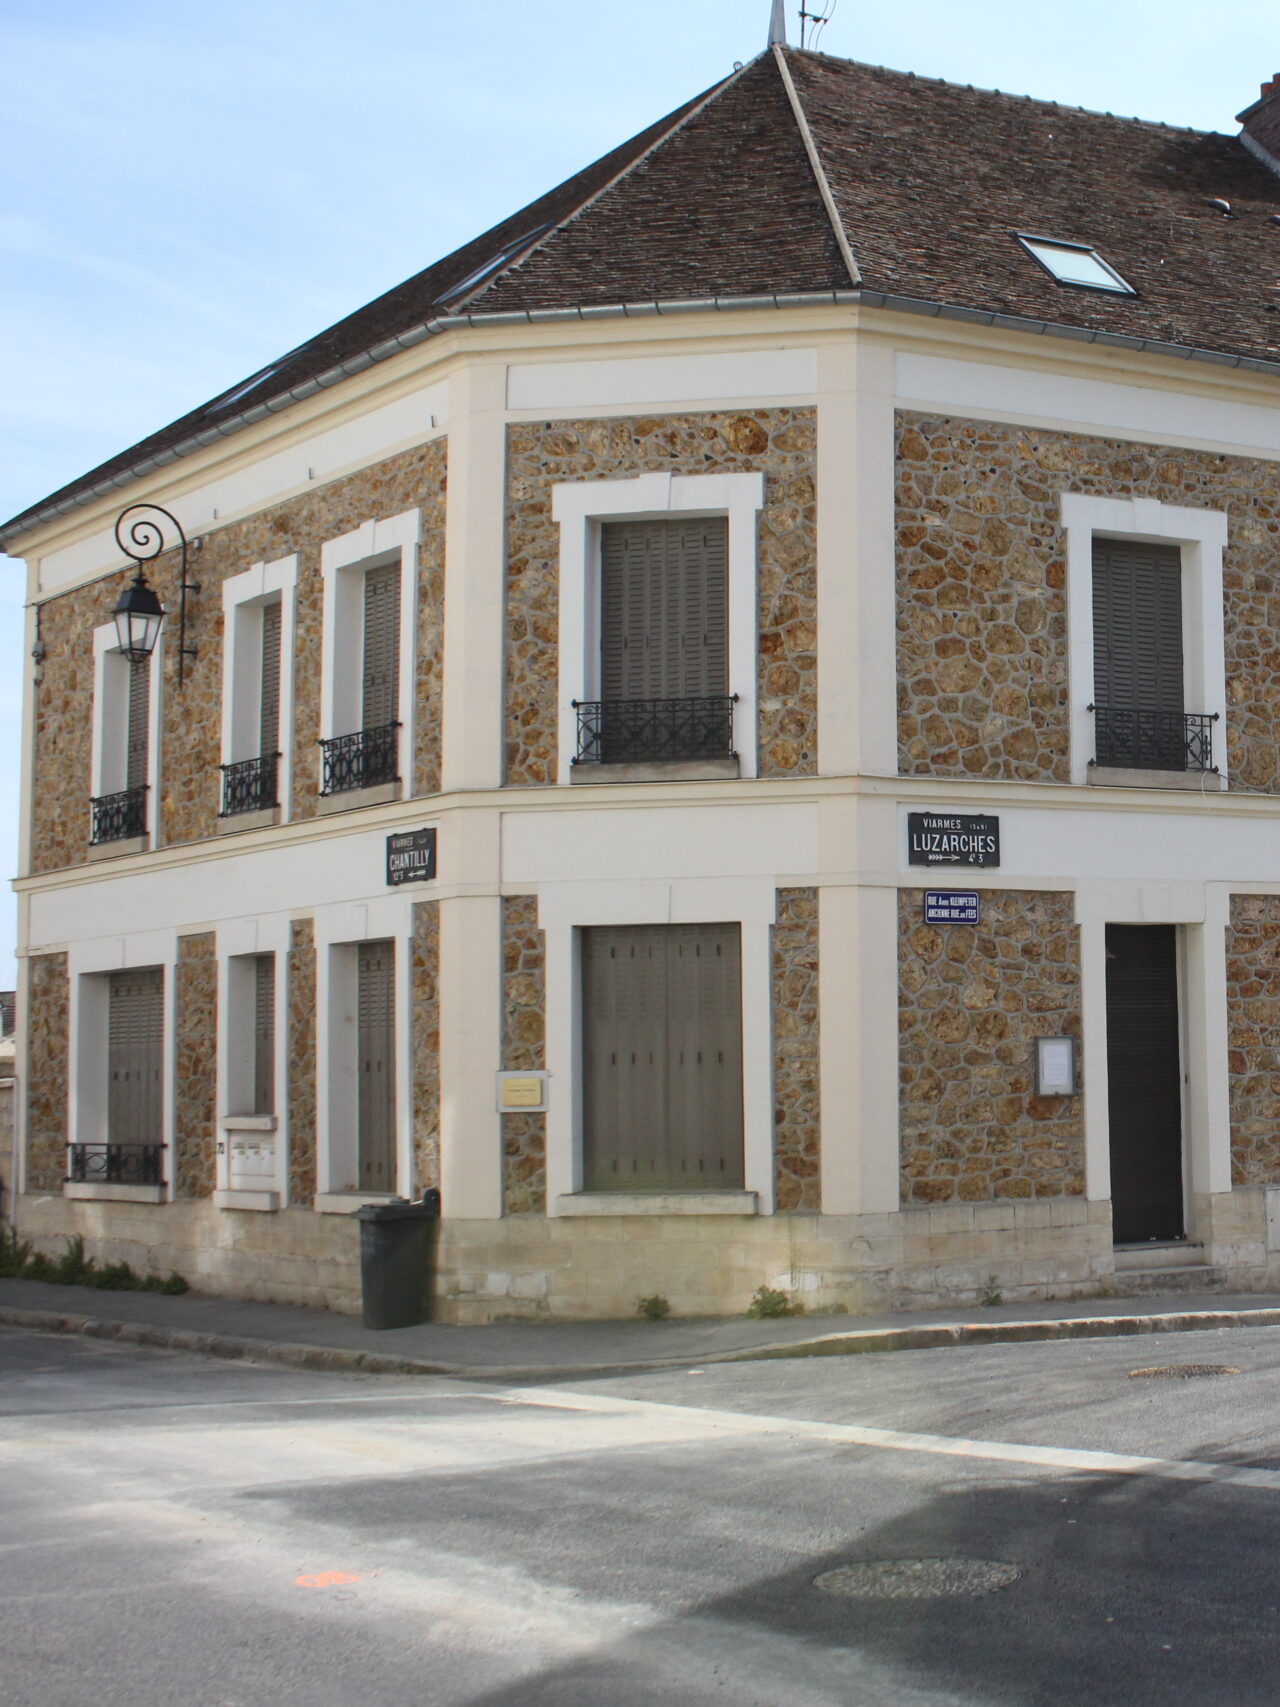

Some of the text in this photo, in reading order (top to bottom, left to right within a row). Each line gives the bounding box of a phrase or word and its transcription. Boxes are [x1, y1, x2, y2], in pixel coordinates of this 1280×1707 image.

[923, 818, 961, 829] VIARMES
[913, 833, 995, 852] LUZARCHES
[390, 849, 430, 870] CHANTILLY
[928, 896, 937, 906] RUE
[928, 908, 950, 918] ANCIENNE
[951, 908, 960, 918] RUE
